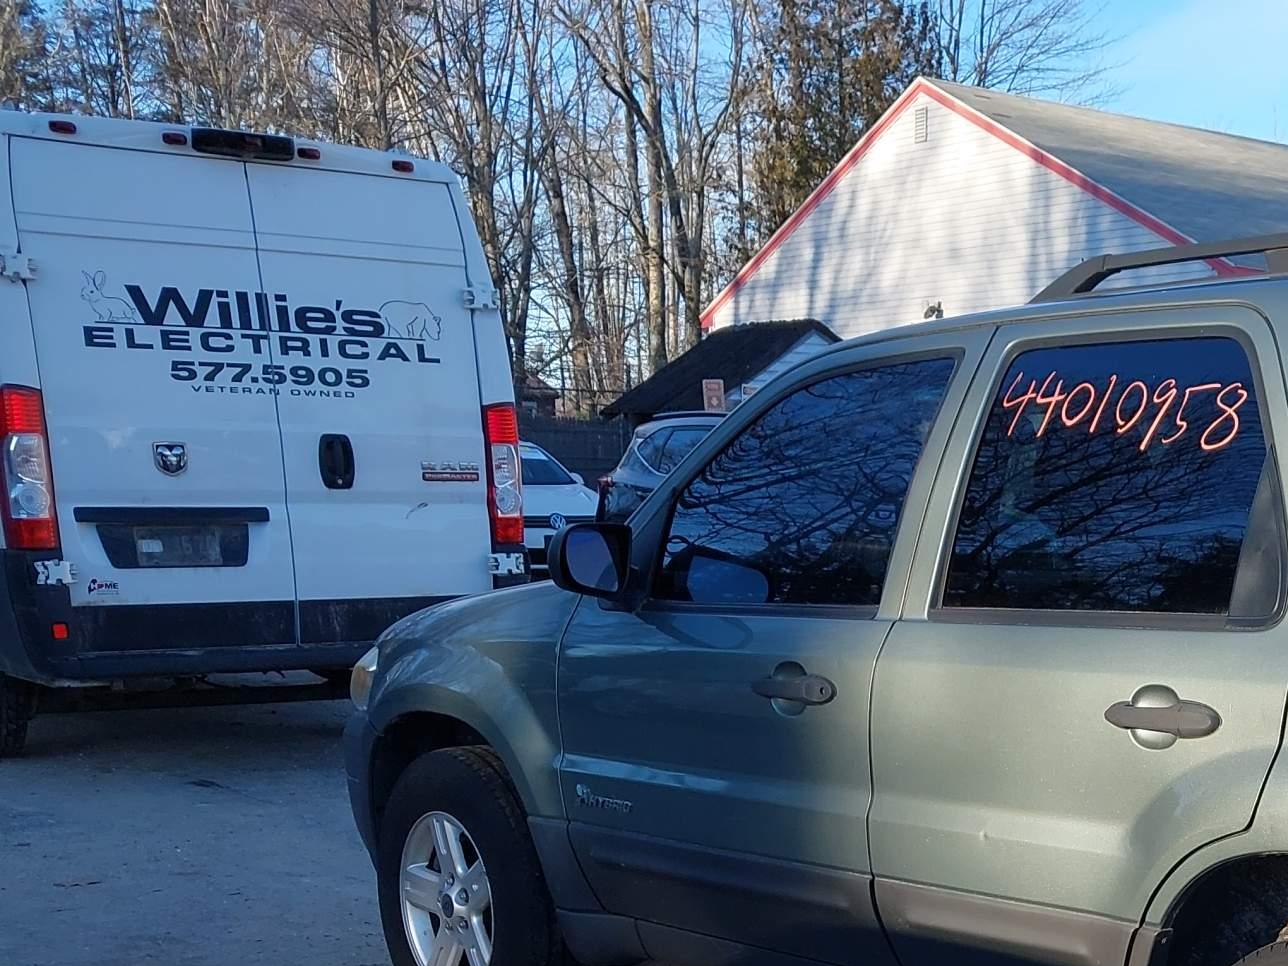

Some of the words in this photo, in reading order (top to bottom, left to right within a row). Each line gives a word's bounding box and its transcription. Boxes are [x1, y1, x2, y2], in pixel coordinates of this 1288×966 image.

[123, 284, 386, 338] Willie's
[82, 325, 441, 364] ELECTRICAL
[169, 359, 370, 389] 577.5905
[191, 384, 280, 396] VETERAN
[290, 388, 355, 399] OWNED
[1003, 372, 1248, 451] 44010958
